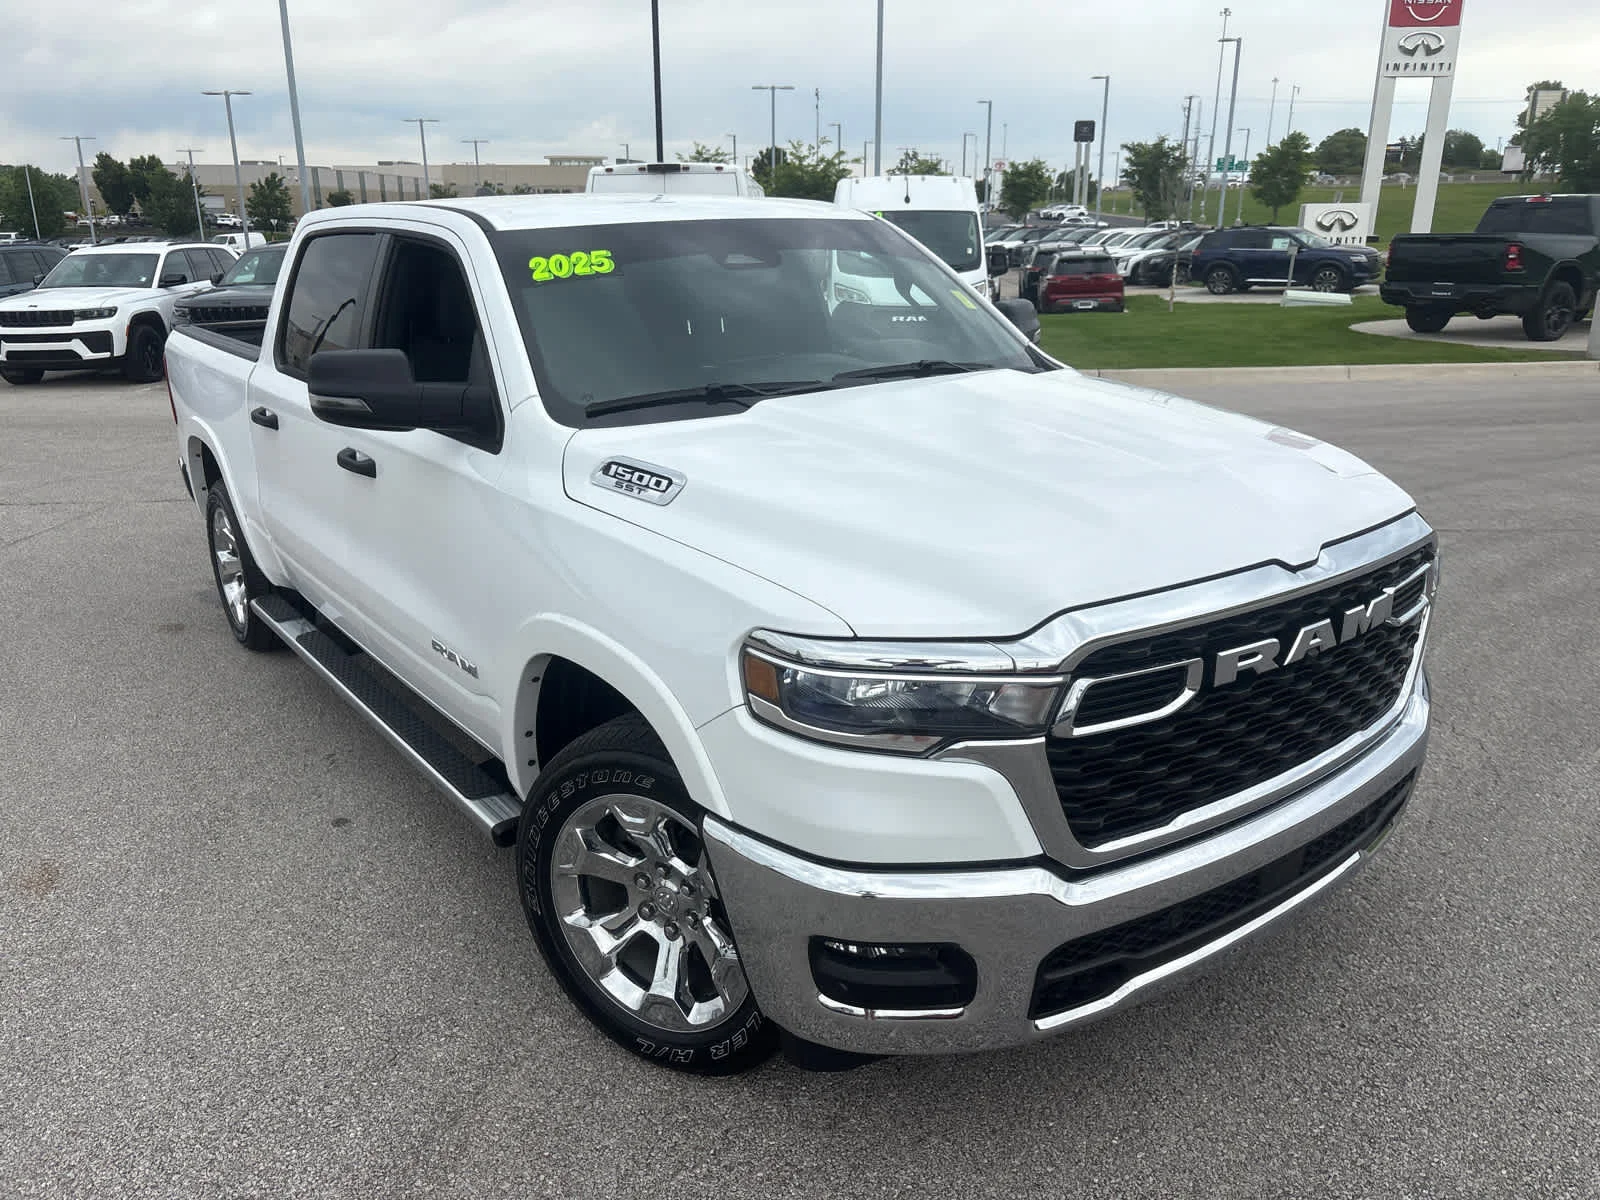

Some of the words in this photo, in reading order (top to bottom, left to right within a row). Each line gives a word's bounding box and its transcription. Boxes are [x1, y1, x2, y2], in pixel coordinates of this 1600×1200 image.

[1385, 62, 1452, 72] INFINITI
[528, 249, 615, 282] 2025
[605, 462, 671, 492] 1500
[613, 480, 647, 495] SST
[1213, 590, 1394, 688] RAM
[431, 637, 480, 680] RAM
